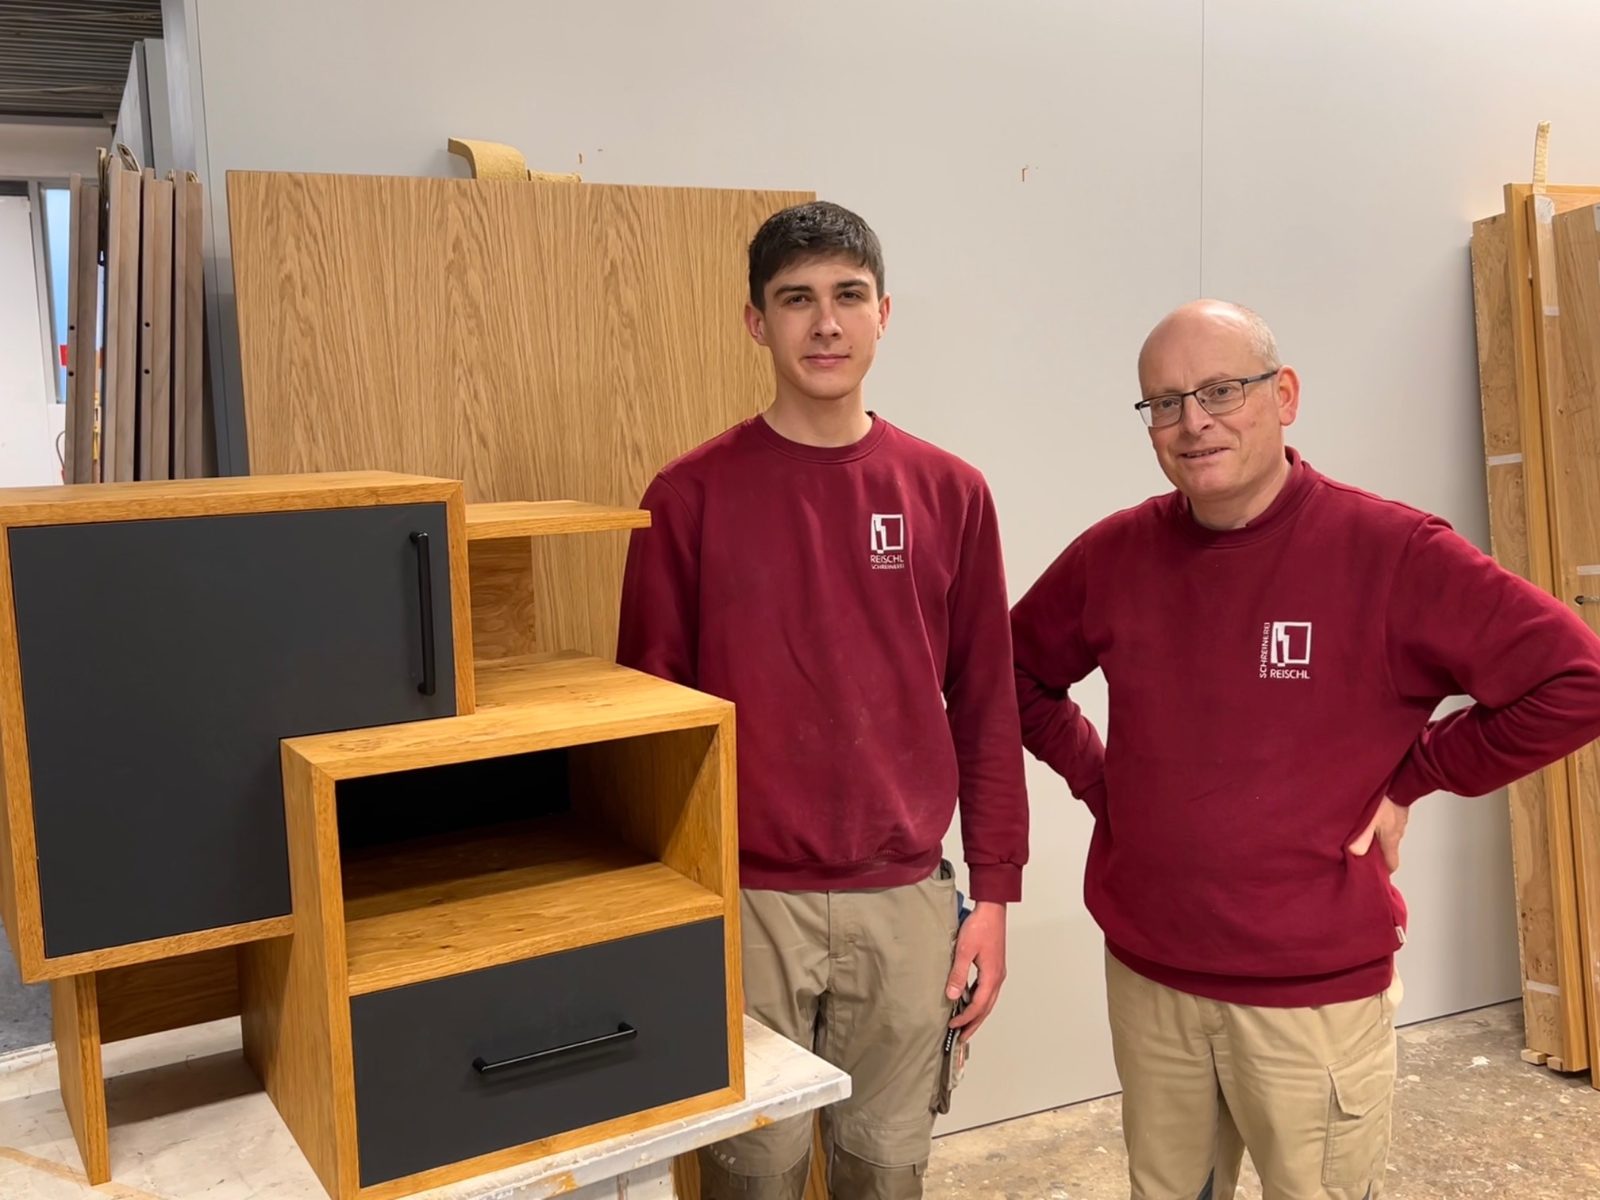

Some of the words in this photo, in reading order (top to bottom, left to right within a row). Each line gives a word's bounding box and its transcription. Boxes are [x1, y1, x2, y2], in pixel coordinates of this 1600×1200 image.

[870, 554, 904, 563] REISCHL
[1259, 622, 1270, 679] SCHREINEREI
[1270, 668, 1310, 679] REISCHL
